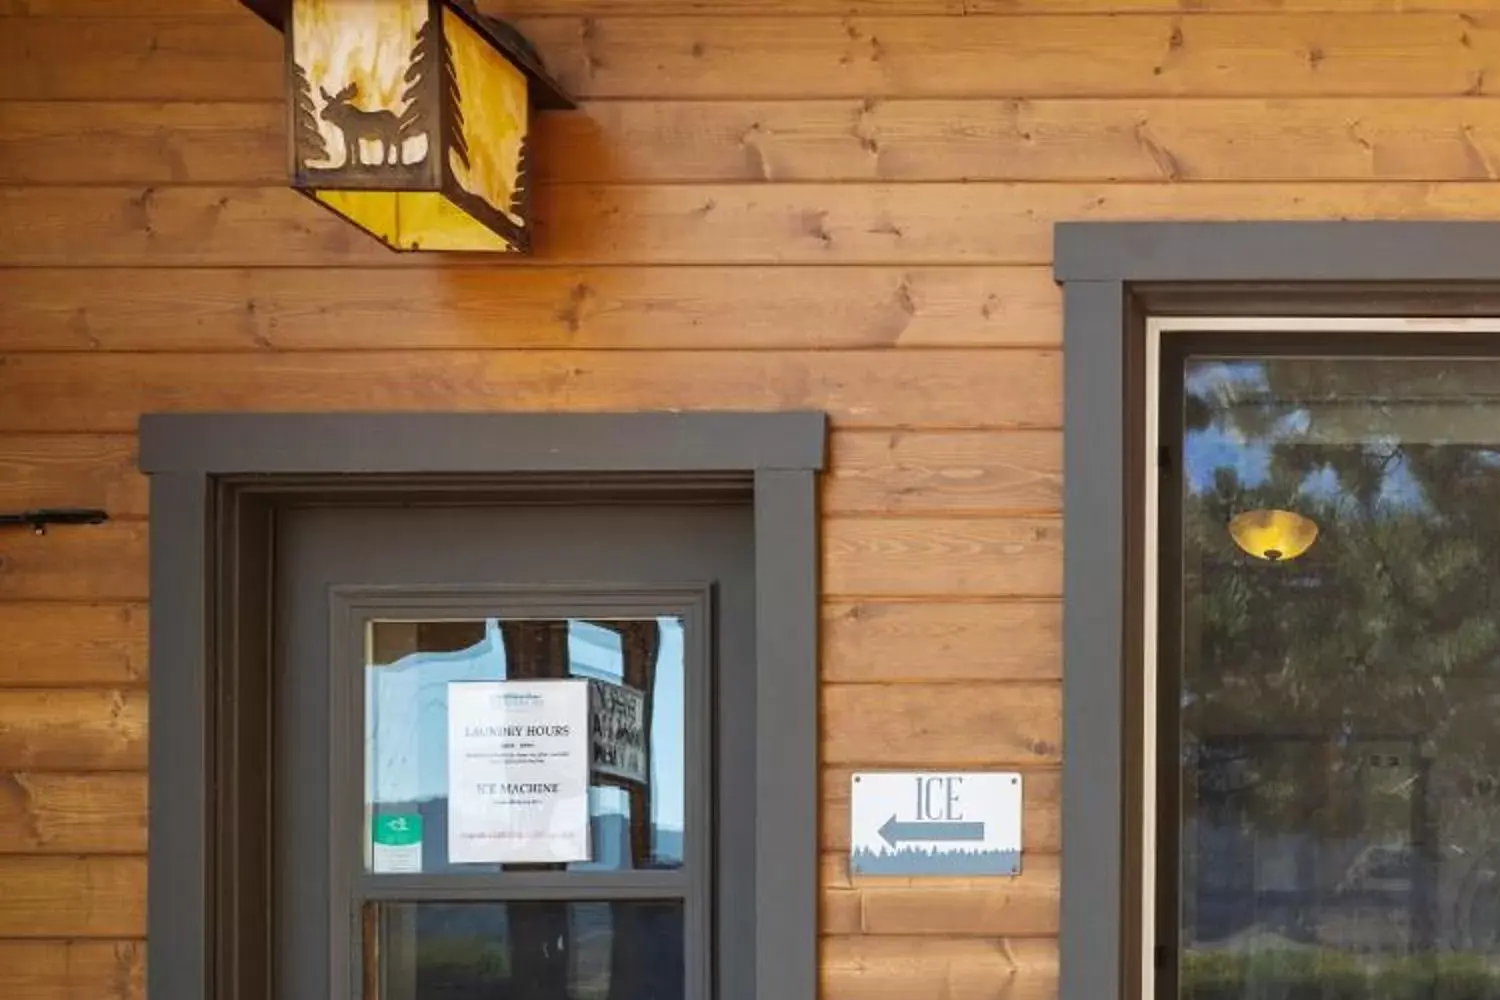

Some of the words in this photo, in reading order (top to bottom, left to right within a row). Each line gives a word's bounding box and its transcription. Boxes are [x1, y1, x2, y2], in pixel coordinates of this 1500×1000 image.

[464, 725, 523, 737] LAUNDRY
[526, 725, 570, 737] HOURS
[476, 783, 497, 795] ICE
[500, 783, 560, 795] MACHINE
[915, 776, 964, 821] ICE
